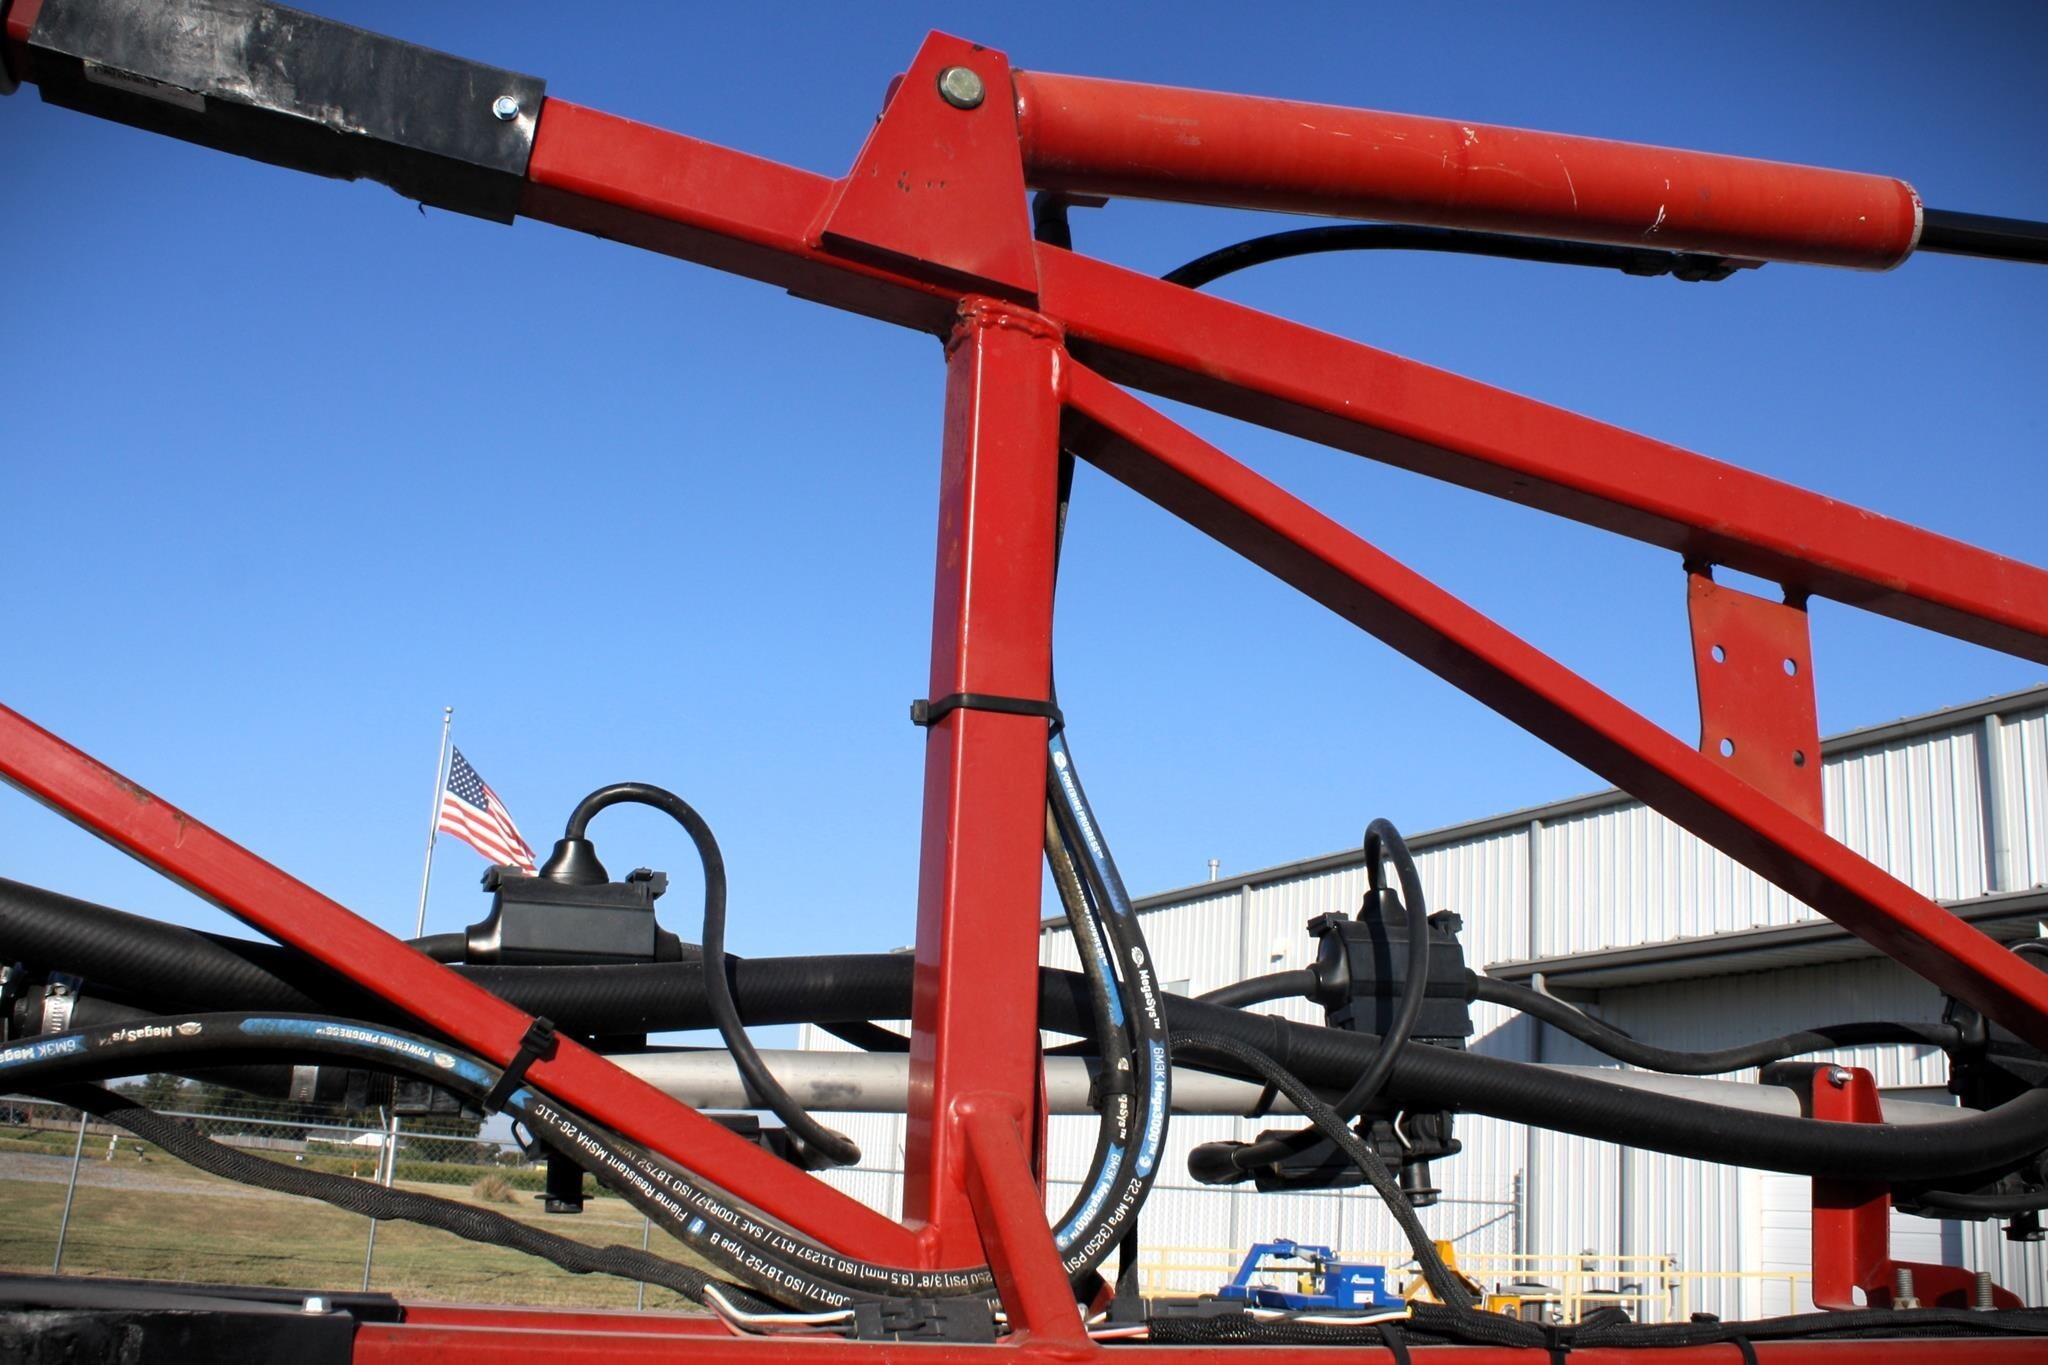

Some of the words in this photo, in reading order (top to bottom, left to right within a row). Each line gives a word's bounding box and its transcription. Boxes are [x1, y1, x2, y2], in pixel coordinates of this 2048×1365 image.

[1061, 770, 1082, 811] POWERING
[37, 1039, 76, 1058] 6M3K
[380, 1036, 431, 1058] POWERING
[1153, 1047, 1166, 1079] 6M3K
[535, 1103, 578, 1138] 2G-11C
[576, 1131, 609, 1161] MSHA
[606, 1155, 654, 1197] Resistant
[637, 1156, 673, 1185] 18752
[1104, 1153, 1121, 1182] 6M3K
[672, 1179, 694, 1198] ISO
[1123, 1178, 1142, 1204] 22.5
[655, 1193, 689, 1222] Flame
[1108, 1202, 1129, 1226] MPa
[709, 1232, 721, 1245] B
[740, 1219, 765, 1238] SAE
[720, 1238, 745, 1262] Type
[771, 1235, 797, 1253] R17
[745, 1253, 784, 1282] 18752
[797, 1247, 834, 1268] 11237
[837, 1260, 858, 1276] ISO
[784, 1275, 806, 1293] ISO
